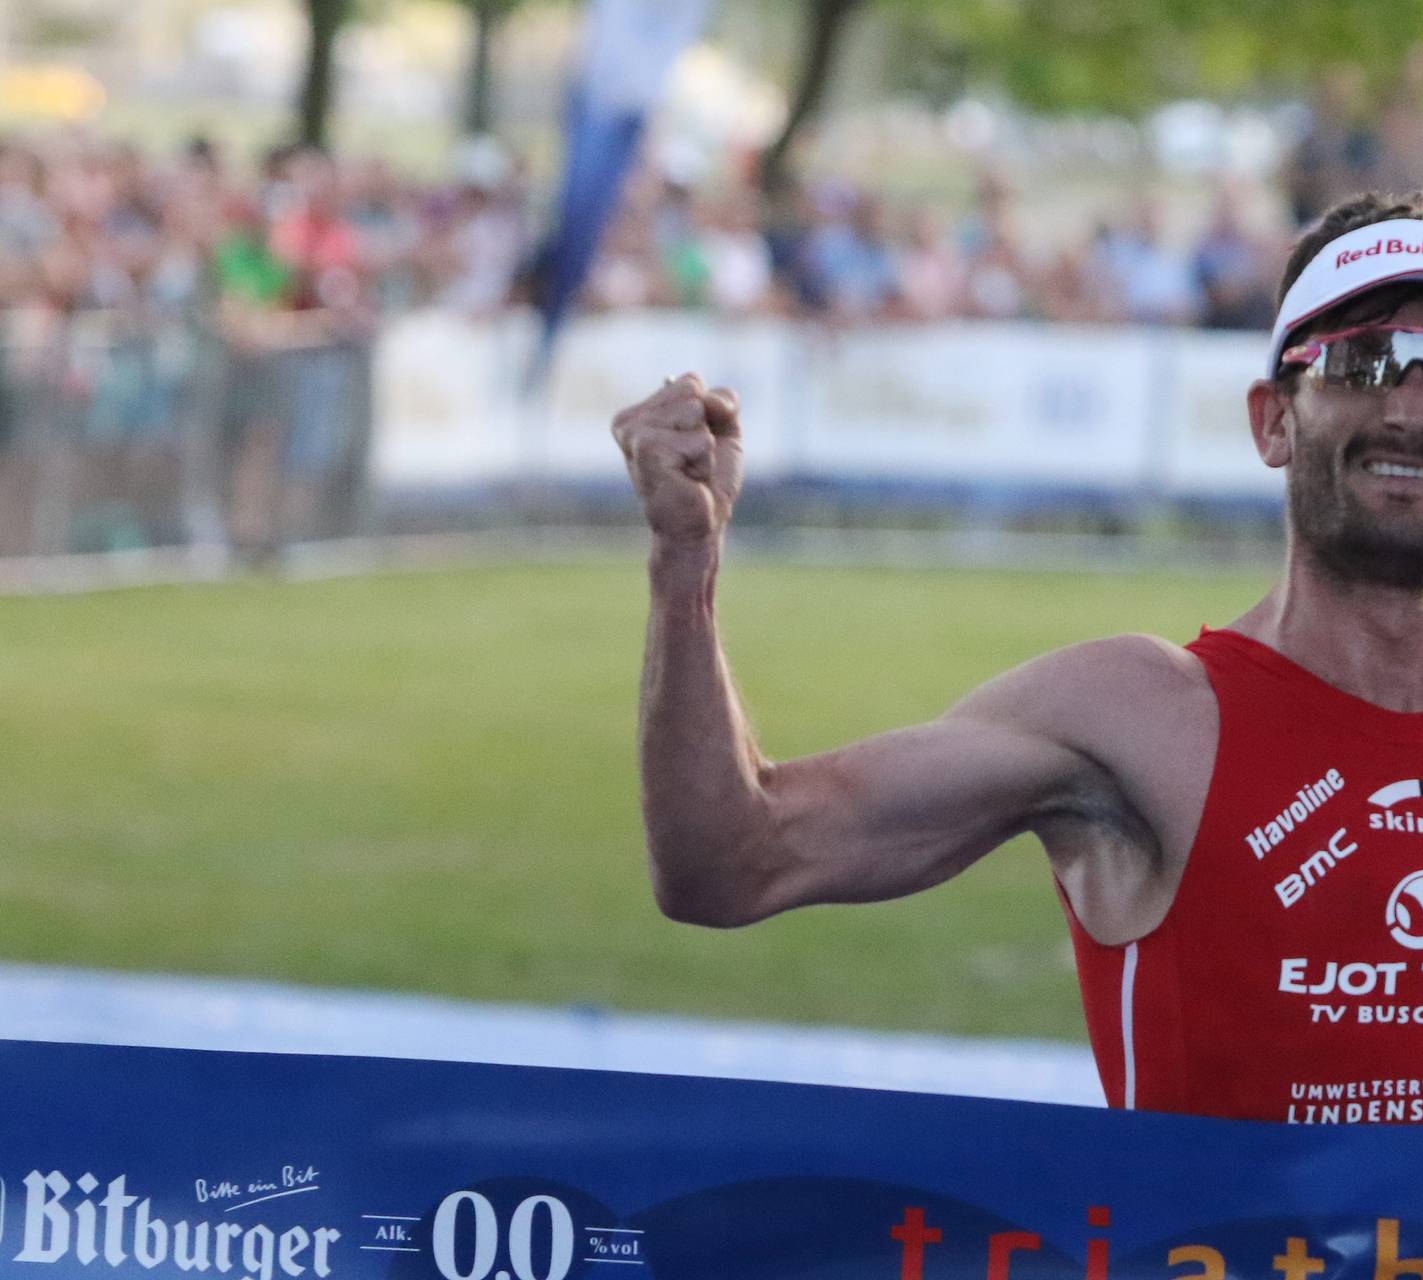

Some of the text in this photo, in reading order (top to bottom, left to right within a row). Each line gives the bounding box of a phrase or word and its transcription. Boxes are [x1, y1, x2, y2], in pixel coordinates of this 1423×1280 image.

[1336, 240, 1381, 269] Red
[1245, 768, 1345, 860] Havoline
[1278, 957, 1408, 996] EJOT
[1309, 1004, 1346, 1024] TV
[195, 1165, 320, 1203] Bitte ein Bit
[12, 1168, 342, 1280] Bitburger
[374, 1225, 413, 1242] Alk.
